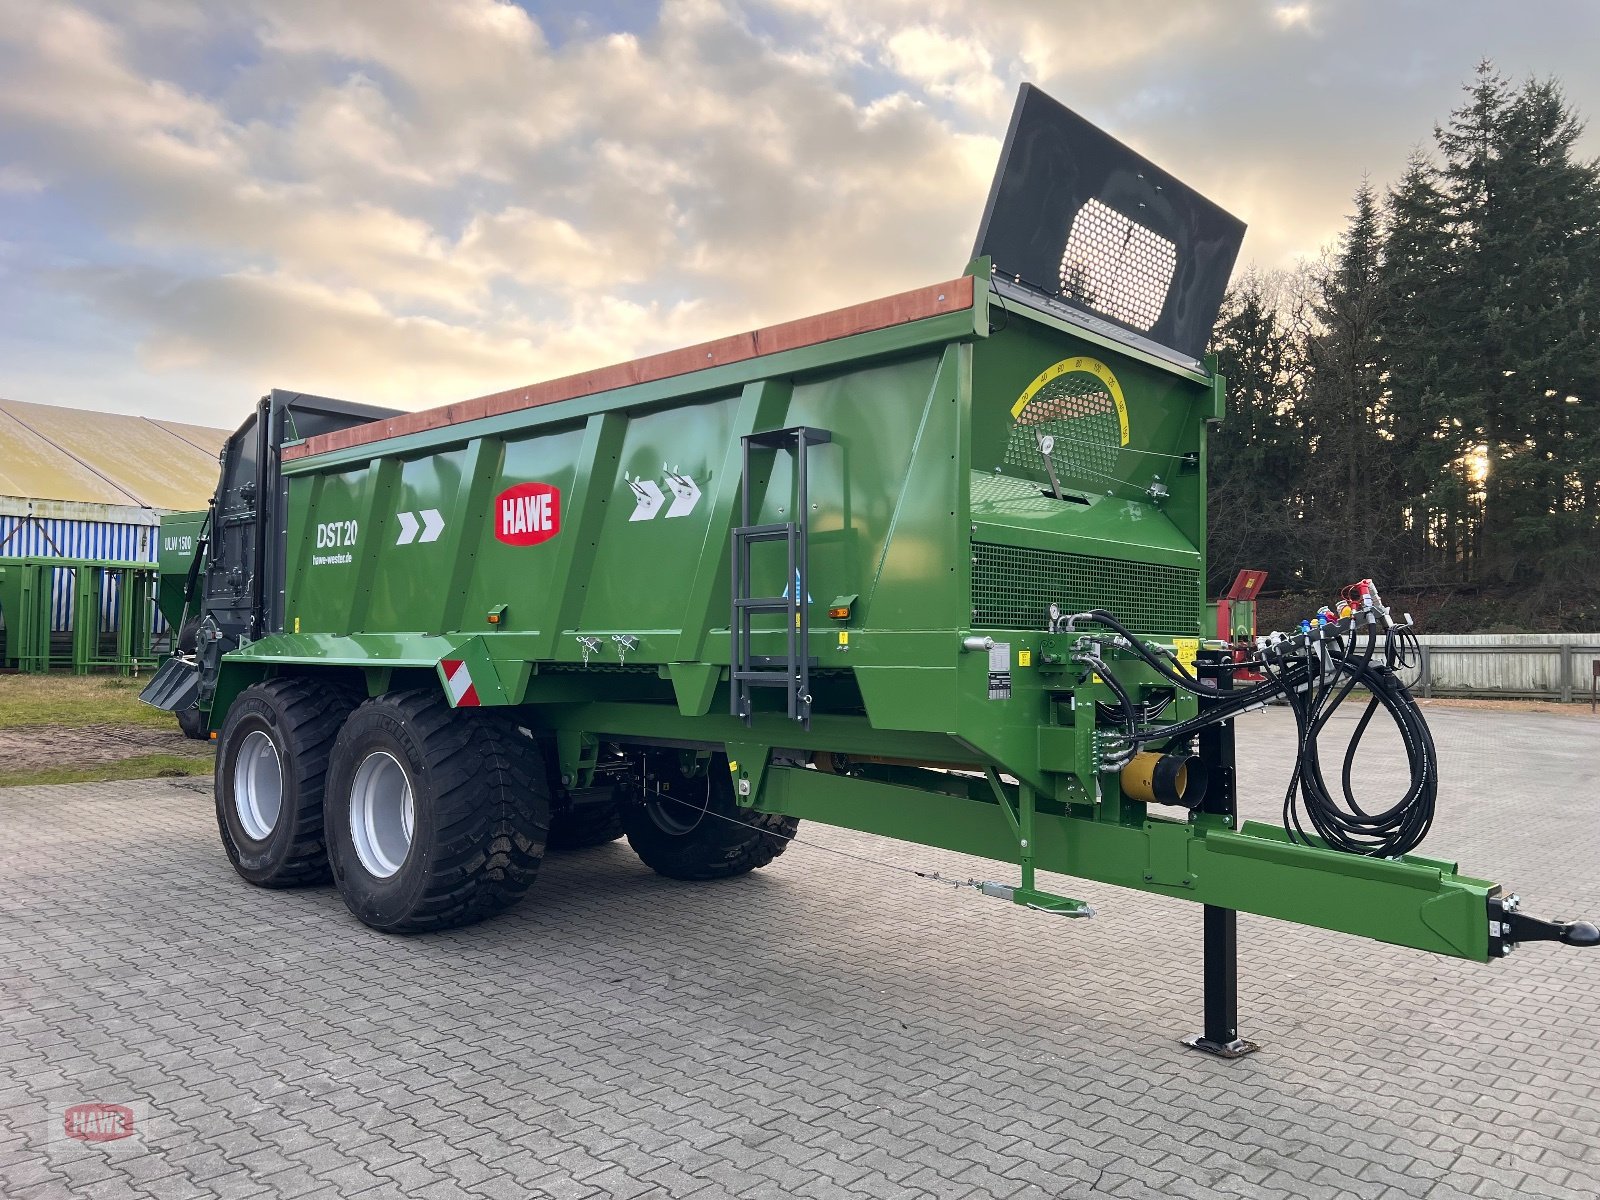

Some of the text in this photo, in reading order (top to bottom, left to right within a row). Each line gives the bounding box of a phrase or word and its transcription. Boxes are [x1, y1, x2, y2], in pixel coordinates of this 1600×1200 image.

[1021, 392, 1029, 403] 20
[1040, 373, 1048, 383] 40
[503, 493, 552, 535] HAWE
[164, 535, 192, 551] ULW 1500
[316, 519, 358, 549] DST 20
[312, 551, 353, 566] hawe-wester.de
